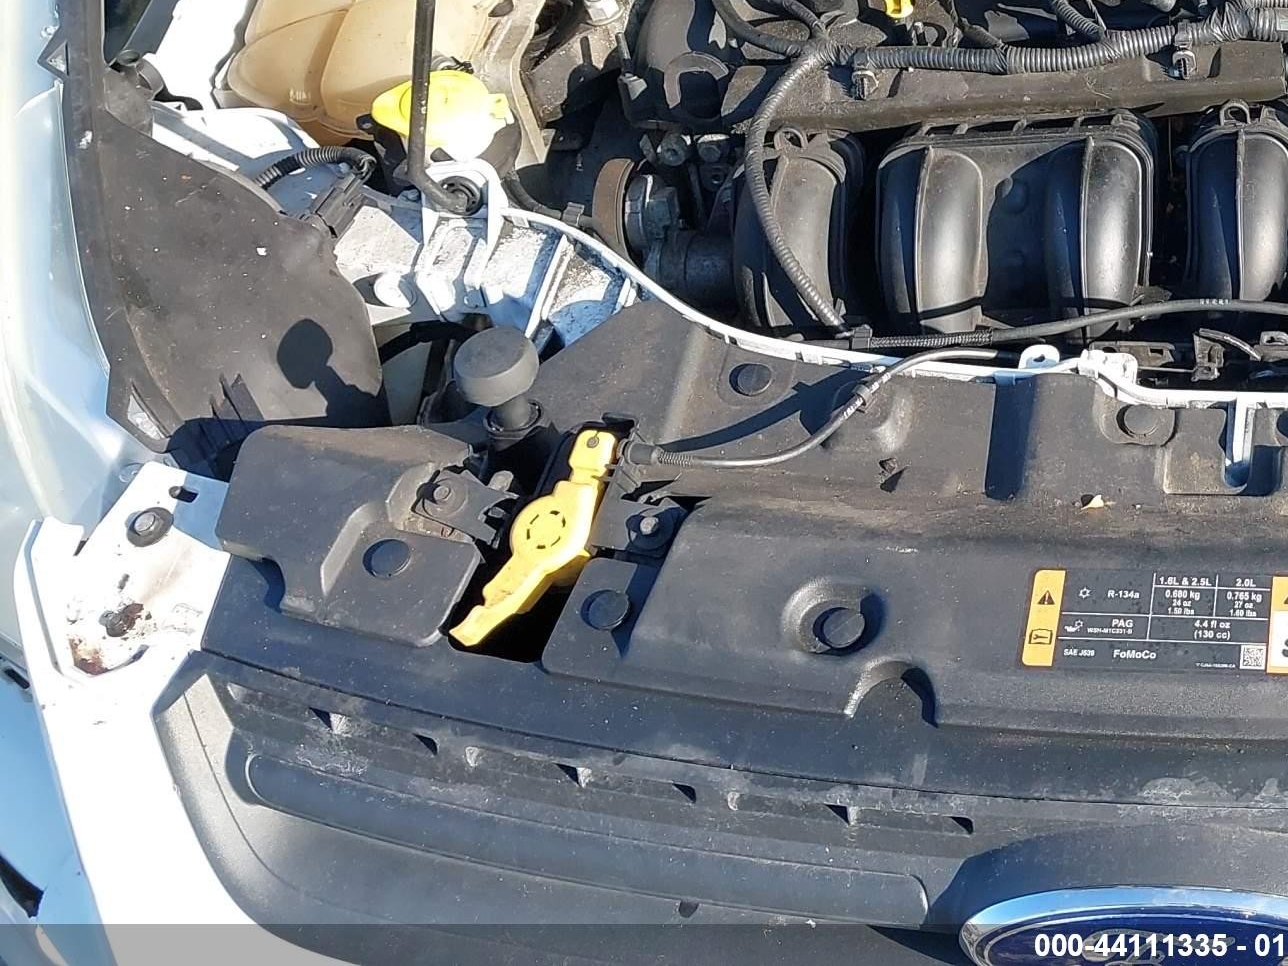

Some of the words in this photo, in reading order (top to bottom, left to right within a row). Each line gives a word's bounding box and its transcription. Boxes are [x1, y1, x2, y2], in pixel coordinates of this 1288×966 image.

[1191, 577, 1212, 586] 2.5L
[1235, 578, 1256, 587] 2.0L
[1107, 589, 1140, 599] R-134a
[1165, 589, 1188, 599] 0.680
[1189, 590, 1201, 601] kg
[1226, 591, 1250, 601] 0.765
[1251, 592, 1262, 603] kg
[1111, 618, 1134, 628] PAG
[1193, 619, 1208, 629] 4.4
[1219, 621, 1231, 629] oz
[1193, 629, 1214, 640] (130
[1215, 630, 1231, 641] cc)
[1063, 648, 1078, 656] SAE
[1112, 649, 1157, 660] FoMoCo
